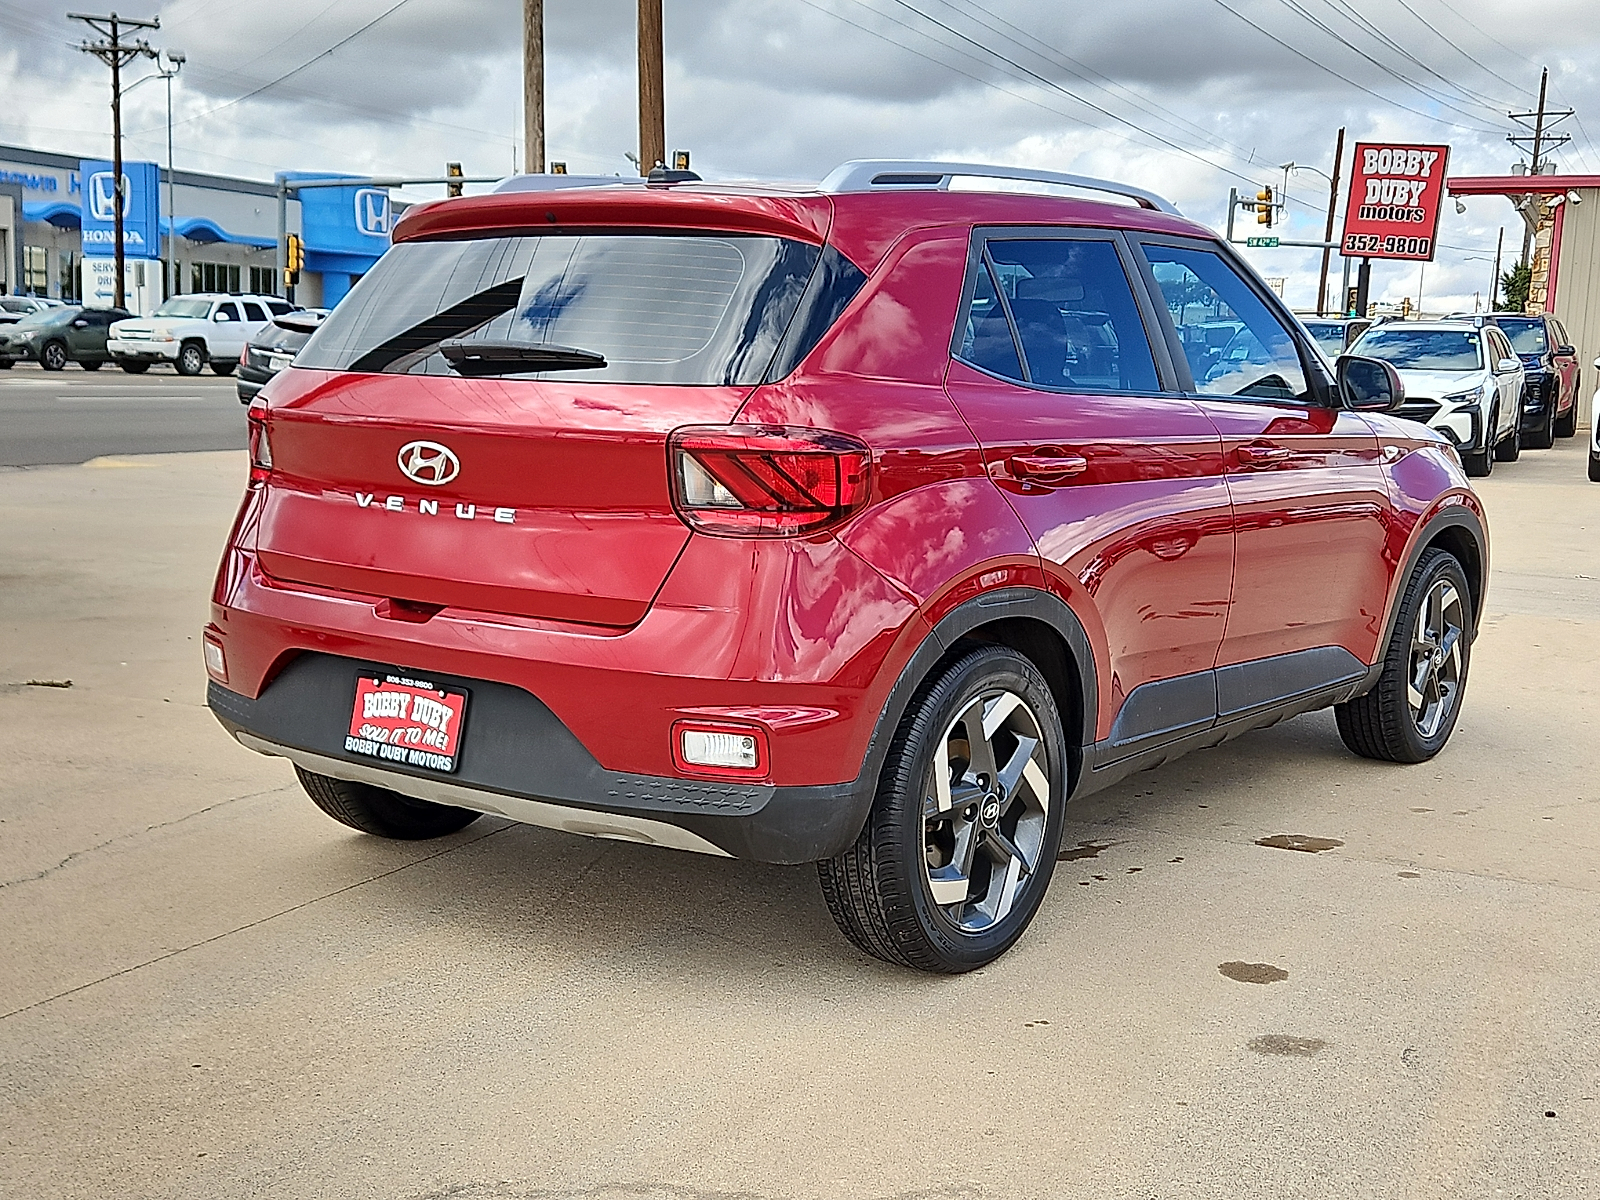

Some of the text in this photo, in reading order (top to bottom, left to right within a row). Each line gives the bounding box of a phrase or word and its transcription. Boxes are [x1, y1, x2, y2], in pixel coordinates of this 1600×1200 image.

[1362, 149, 1438, 177] BOBBY
[1365, 178, 1427, 207] DUBY
[1359, 205, 1425, 223] motors
[1346, 234, 1430, 256] 352-9800
[92, 262, 131, 273] SERVE
[355, 492, 516, 524] VENUE
[363, 691, 454, 733] BOBBY DUBY
[358, 723, 449, 751] SOLD IT TO ME!
[345, 737, 452, 771] BOBBY DUBY MOTORS
